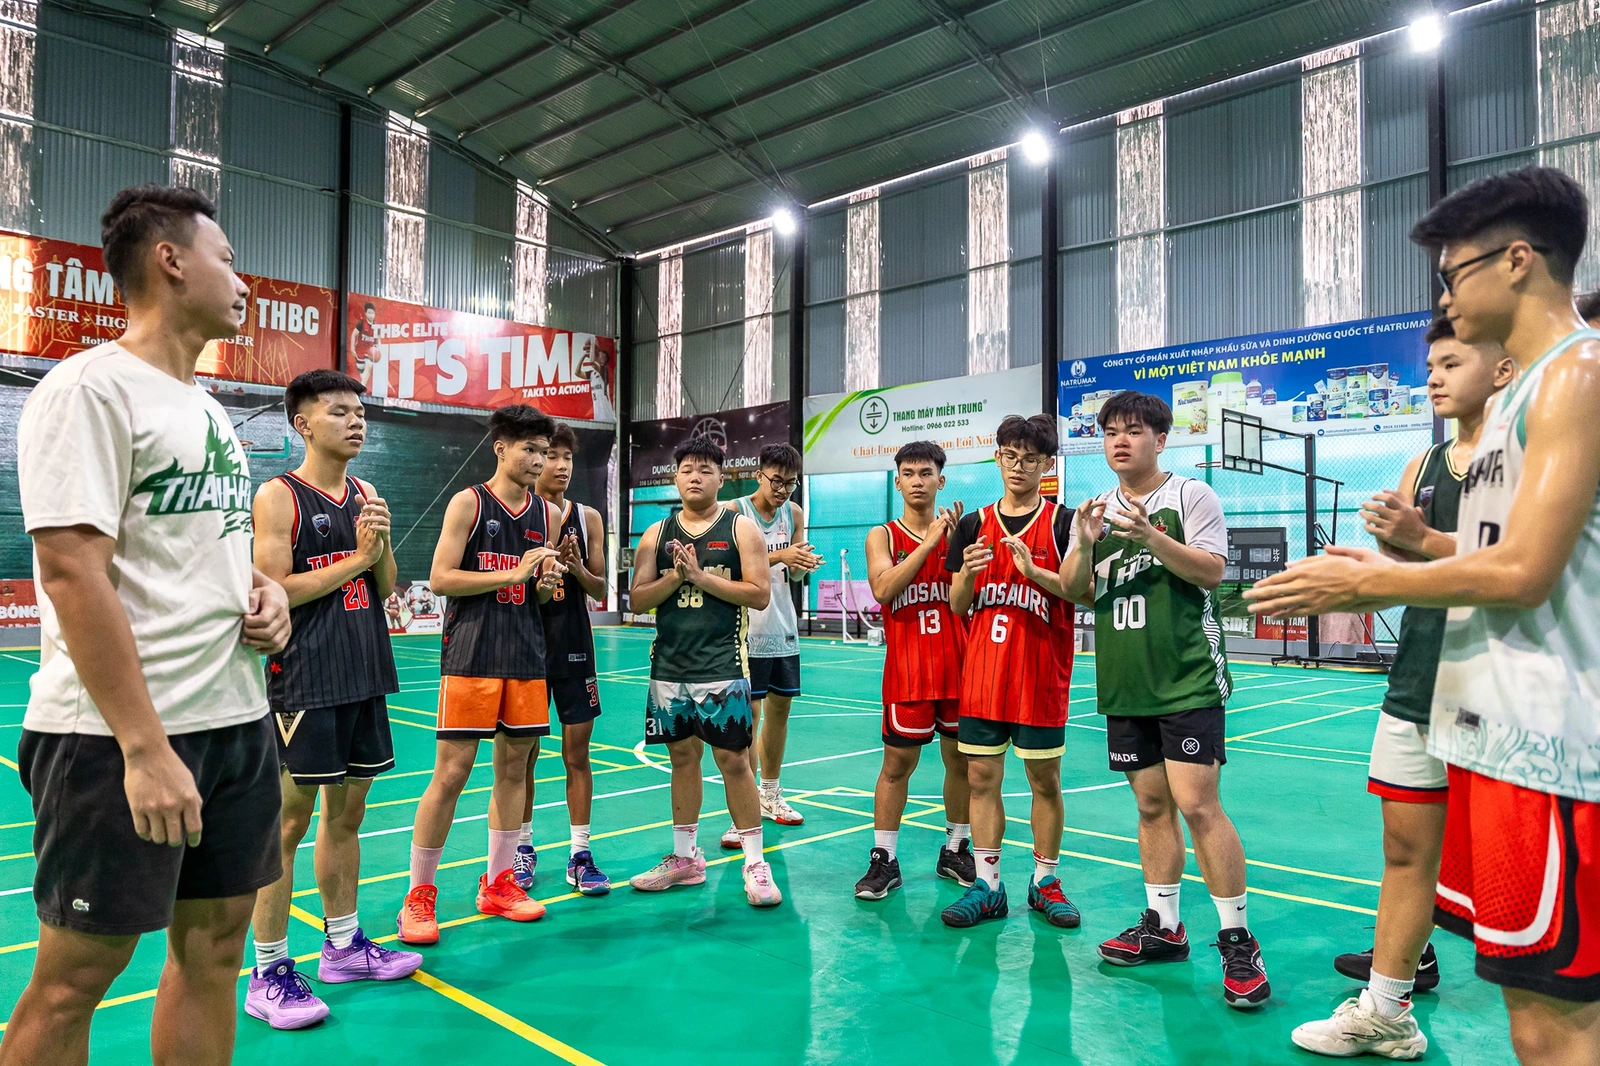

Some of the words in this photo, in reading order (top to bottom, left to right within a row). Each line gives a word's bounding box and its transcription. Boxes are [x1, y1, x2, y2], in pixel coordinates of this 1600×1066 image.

[45, 257, 115, 306] TÂM
[95, 314, 129, 329] HIG
[256, 297, 319, 336] THBC
[371, 323, 410, 339] THBC
[412, 321, 449, 337] ELITE
[1103, 360, 1124, 368] CÔNG
[1259, 339, 1271, 348] VÀ
[1273, 336, 1296, 346] DINH
[1376, 318, 1433, 333] NATRUMAX
[371, 338, 468, 399] IT'S
[1134, 367, 1146, 380] VÌ
[1148, 364, 1175, 380] MỘT
[1177, 360, 1205, 376] VIỆT
[1207, 358, 1238, 371] NAM
[1241, 350, 1278, 368] KHỎE
[1281, 347, 1326, 365] MẠNH
[522, 387, 544, 399] TAKE
[545, 386, 557, 396] TO
[558, 383, 590, 396] ACTION!
[1060, 376, 1097, 387] NATRUMAX
[892, 410, 916, 422] THANG
[917, 406, 934, 419] MÁY
[957, 401, 983, 414] TRUNG
[901, 425, 926, 433] Hotline:
[926, 421, 943, 430] 0966
[943, 420, 956, 428] 022
[957, 418, 970, 426] 533
[735, 455, 757, 468] BÓNG
[477, 551, 520, 571] THANH
[341, 578, 369, 611] 20
[677, 584, 704, 608] 38
[0, 602, 40, 619] BÓNG
[1112, 594, 1147, 631] 00
[918, 608, 941, 635] 13
[991, 613, 1009, 644] 6
[646, 717, 664, 736] 31
[1109, 751, 1139, 762] WADE
